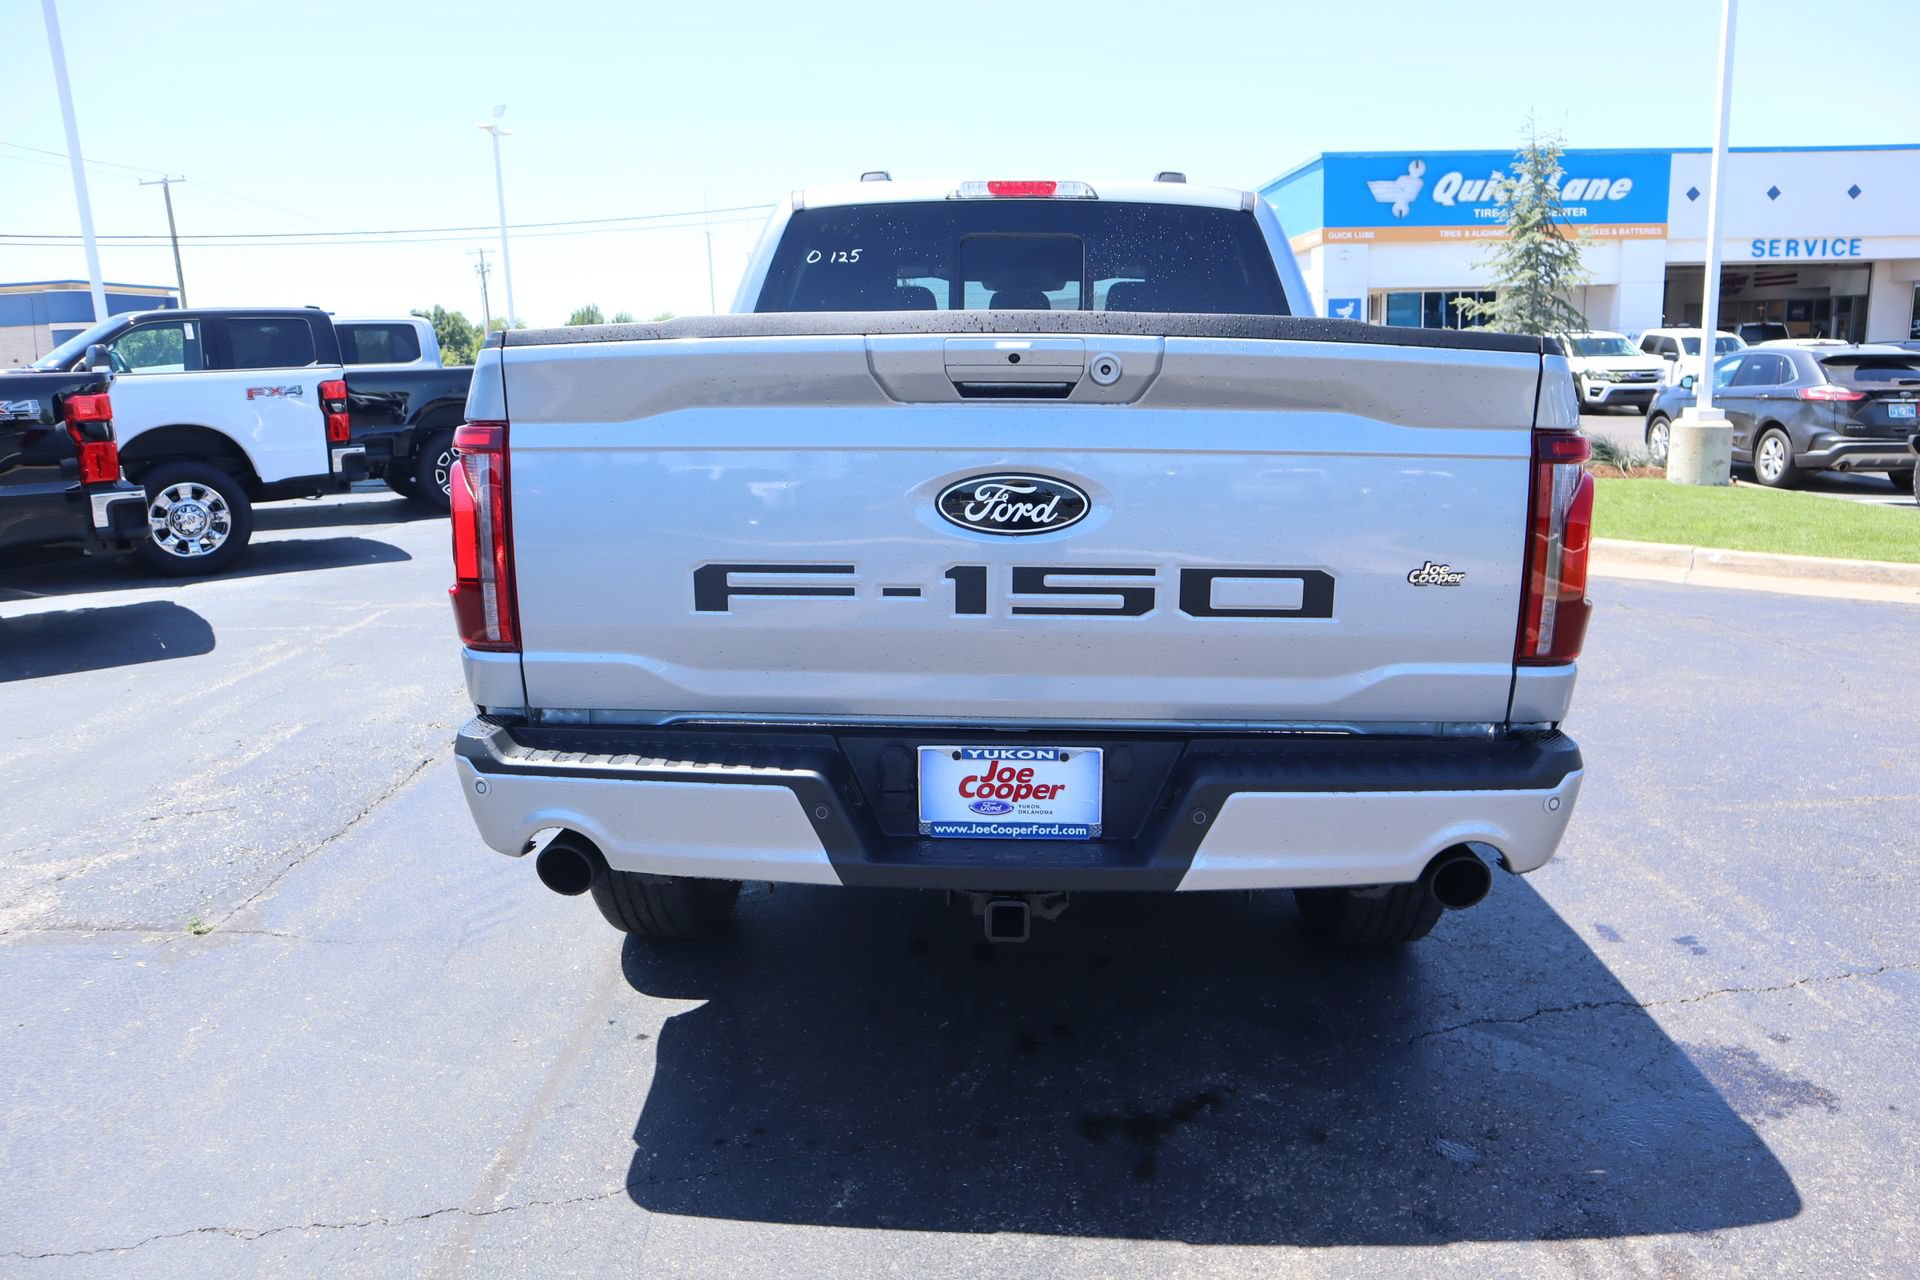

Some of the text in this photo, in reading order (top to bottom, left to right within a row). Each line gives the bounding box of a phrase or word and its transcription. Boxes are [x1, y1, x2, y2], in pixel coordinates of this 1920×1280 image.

[1432, 171, 1533, 206] Quik
[1619, 227, 1664, 236] BATTERIES
[830, 248, 863, 263] 125
[1751, 238, 1863, 258] SERVICE
[246, 384, 304, 400] FX4
[964, 483, 1062, 523] Ford
[1420, 560, 1450, 575] Joe
[1407, 568, 1466, 585] Cooper
[692, 562, 1337, 620] F-150
[967, 749, 1054, 760] YUKON
[980, 760, 1035, 783] Joe
[958, 775, 1066, 803] Cooper
[934, 823, 1087, 837] www.JoeCooperFord.com
